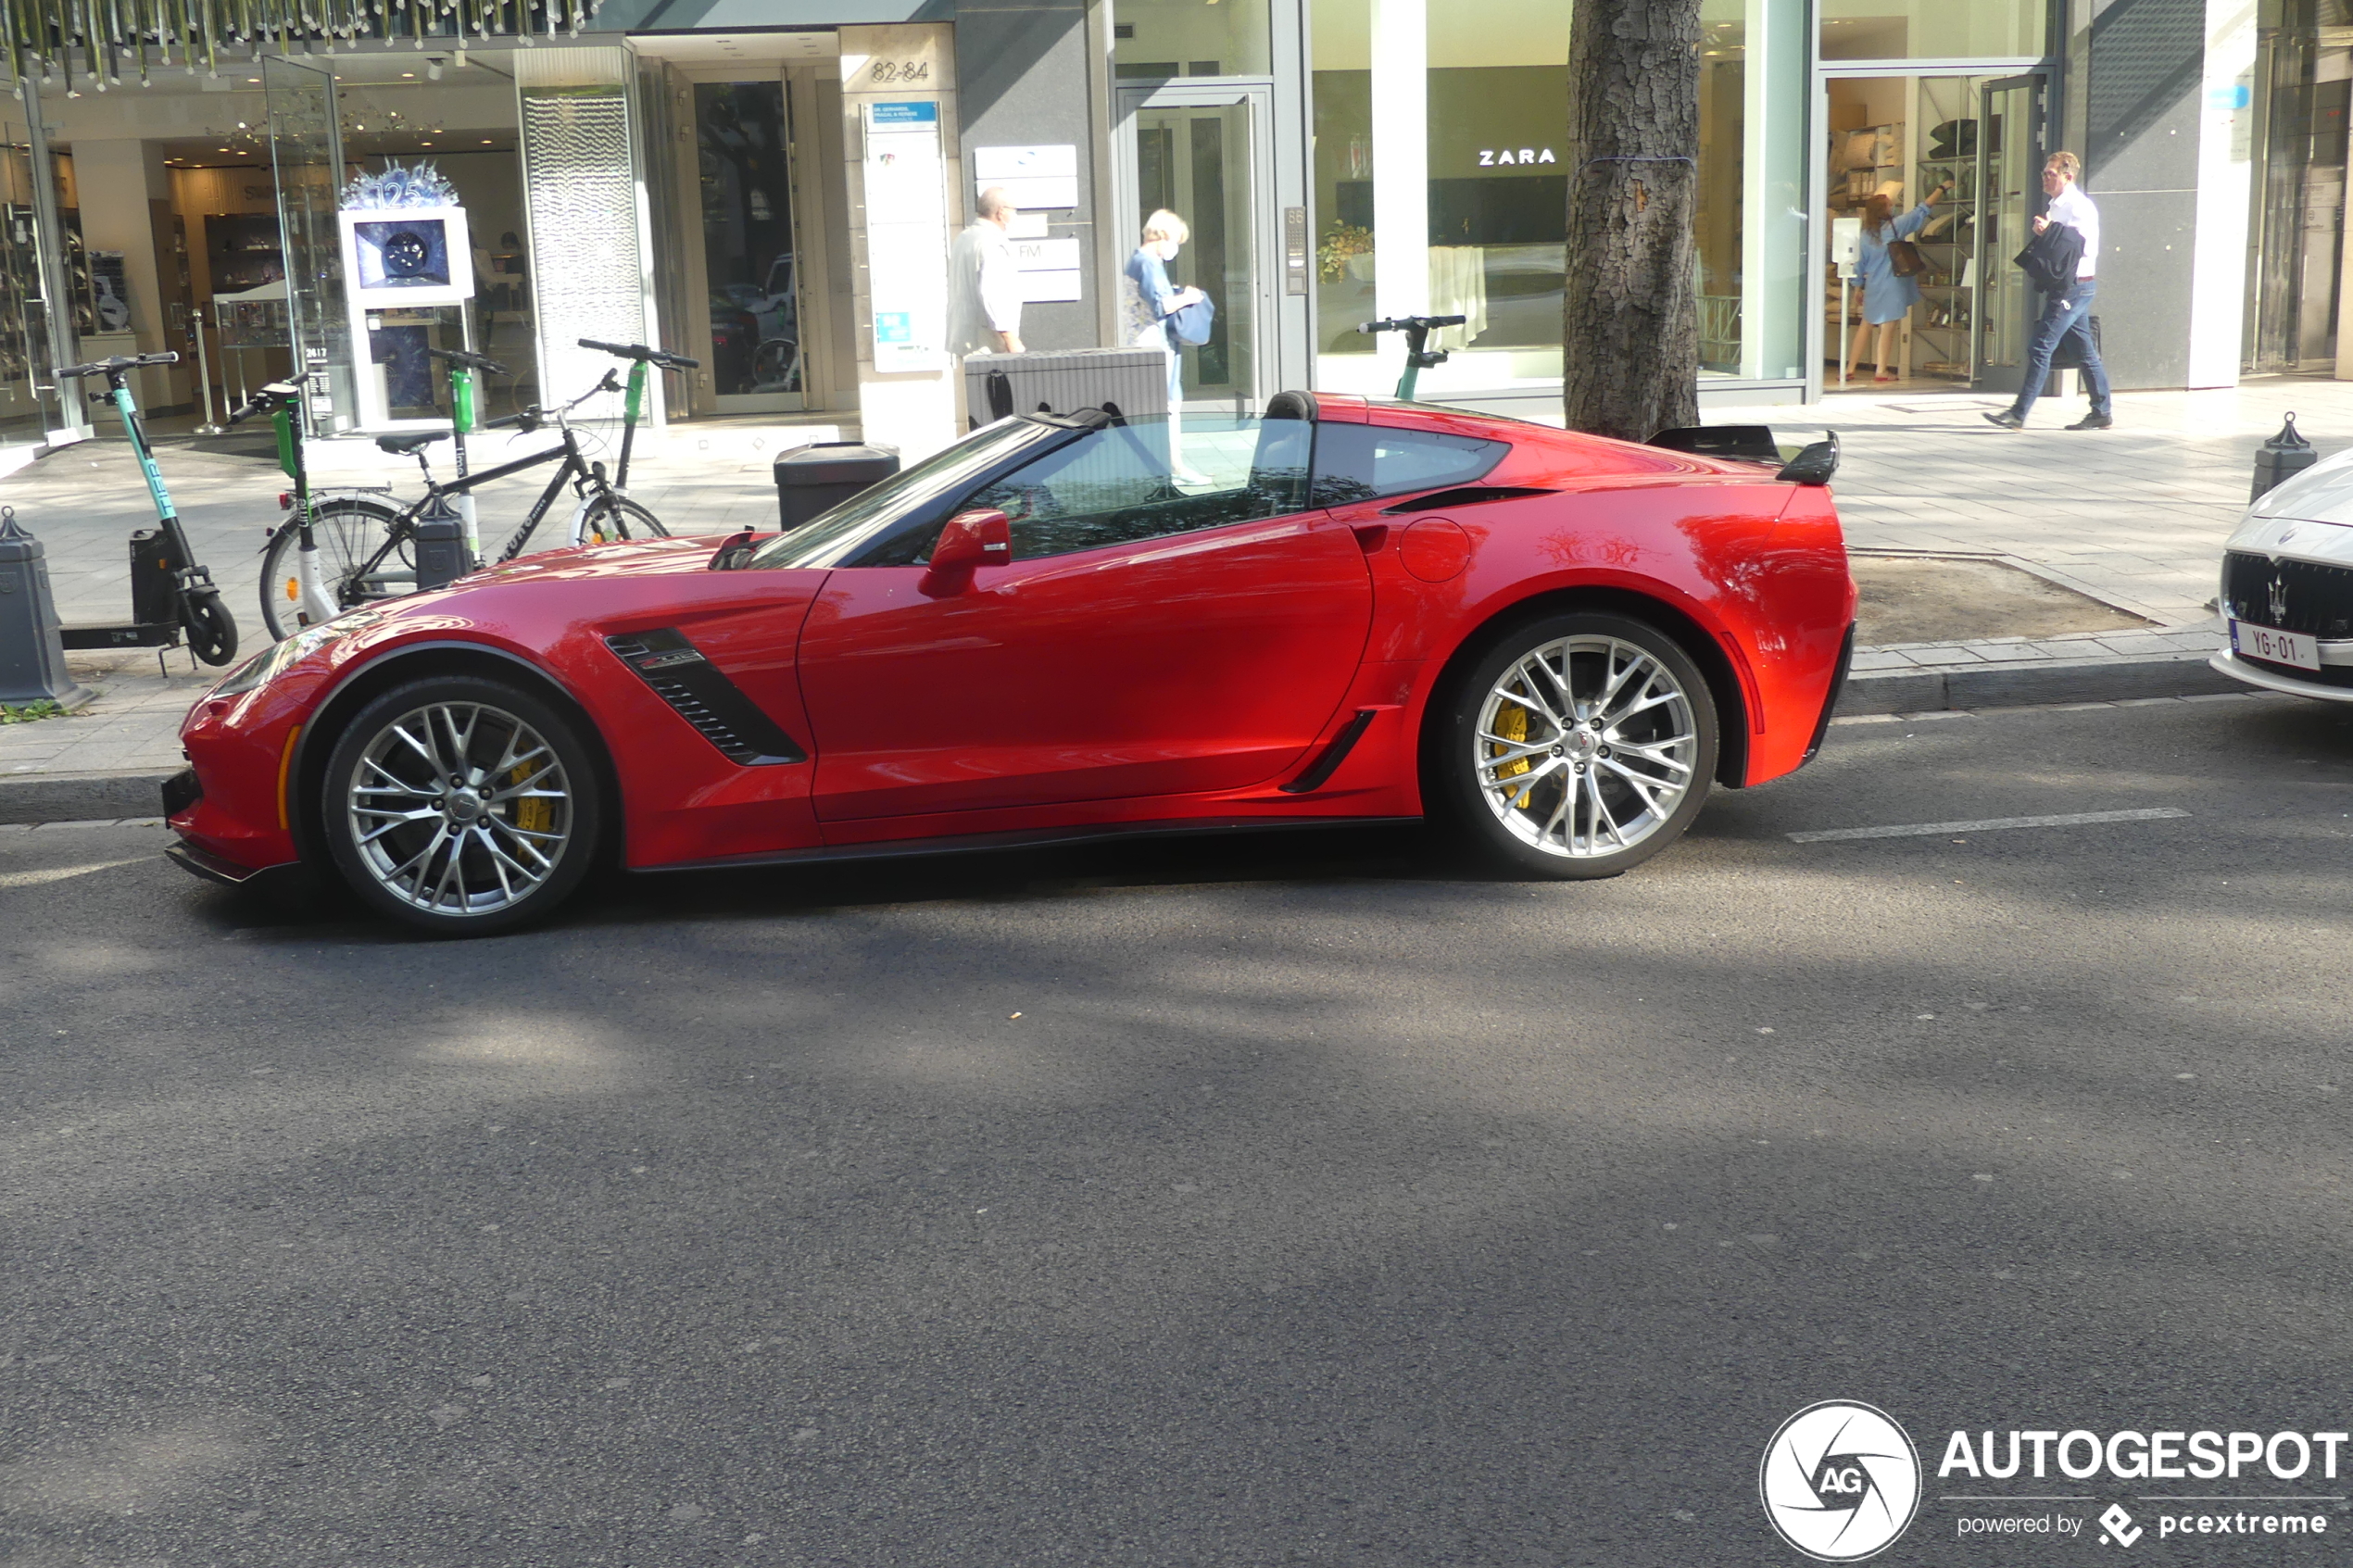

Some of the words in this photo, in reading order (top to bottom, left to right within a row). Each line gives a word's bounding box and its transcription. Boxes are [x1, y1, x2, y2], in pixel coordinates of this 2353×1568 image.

[873, 61, 929, 82] 82-84
[1479, 148, 1555, 166] ZARA
[374, 182, 421, 209] 125
[1289, 210, 1303, 223] 86
[148, 463, 172, 515] TIER
